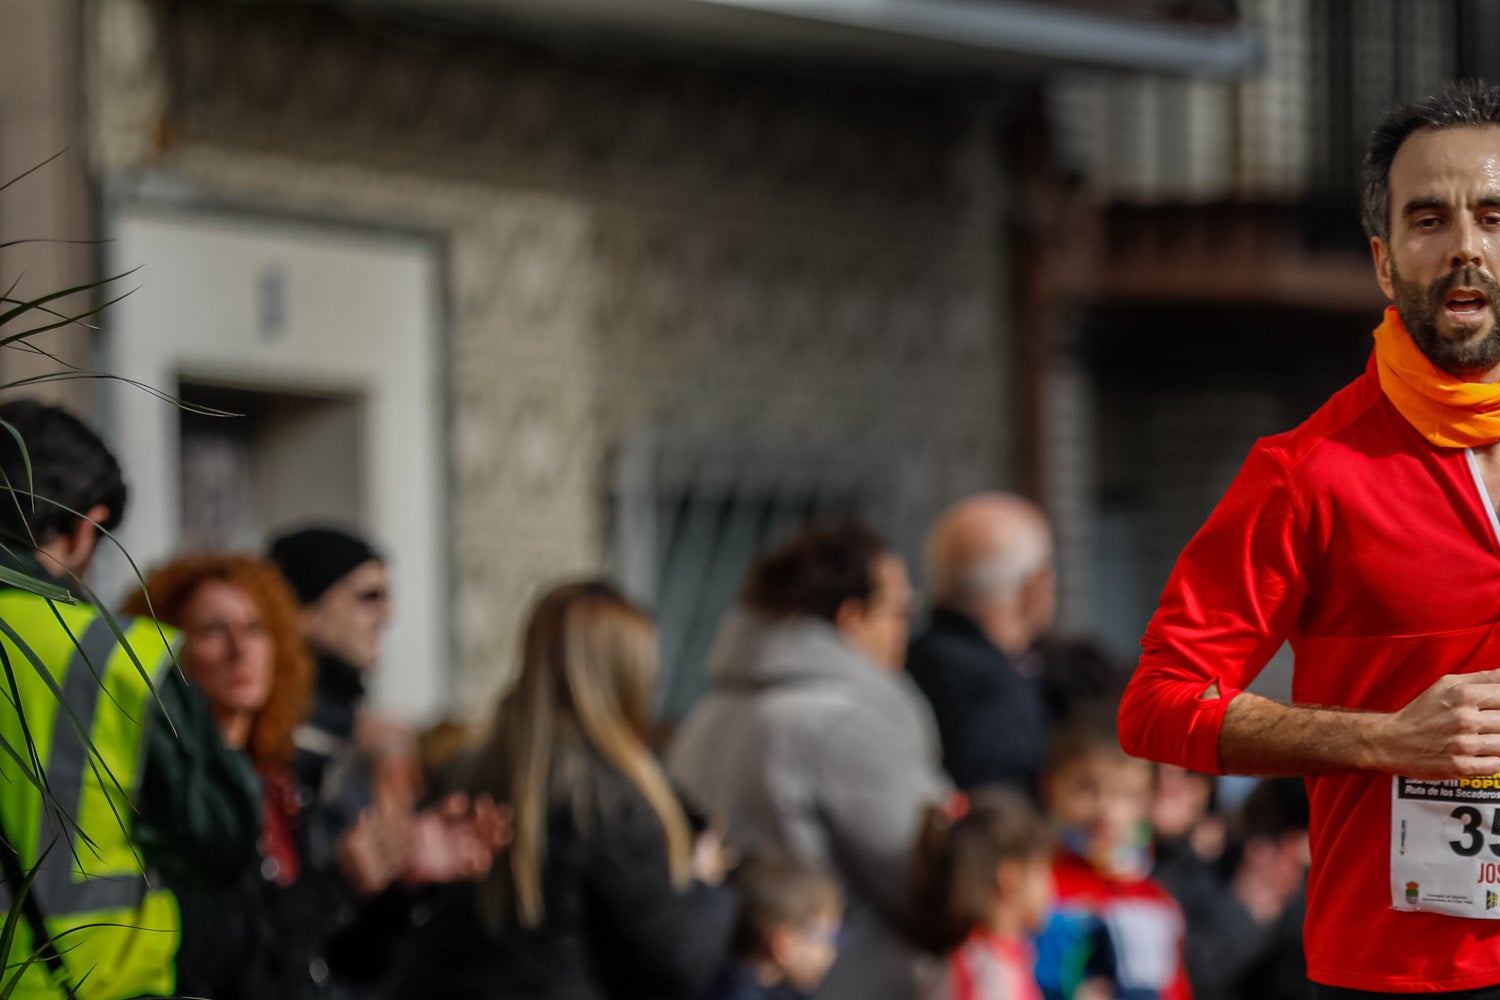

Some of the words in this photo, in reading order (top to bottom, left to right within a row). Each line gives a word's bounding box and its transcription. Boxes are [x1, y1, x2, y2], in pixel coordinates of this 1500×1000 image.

[1405, 785, 1426, 795] Ruta
[1427, 787, 1439, 796] de
[1440, 788, 1453, 797] los
[1456, 789, 1500, 799] Secaderos
